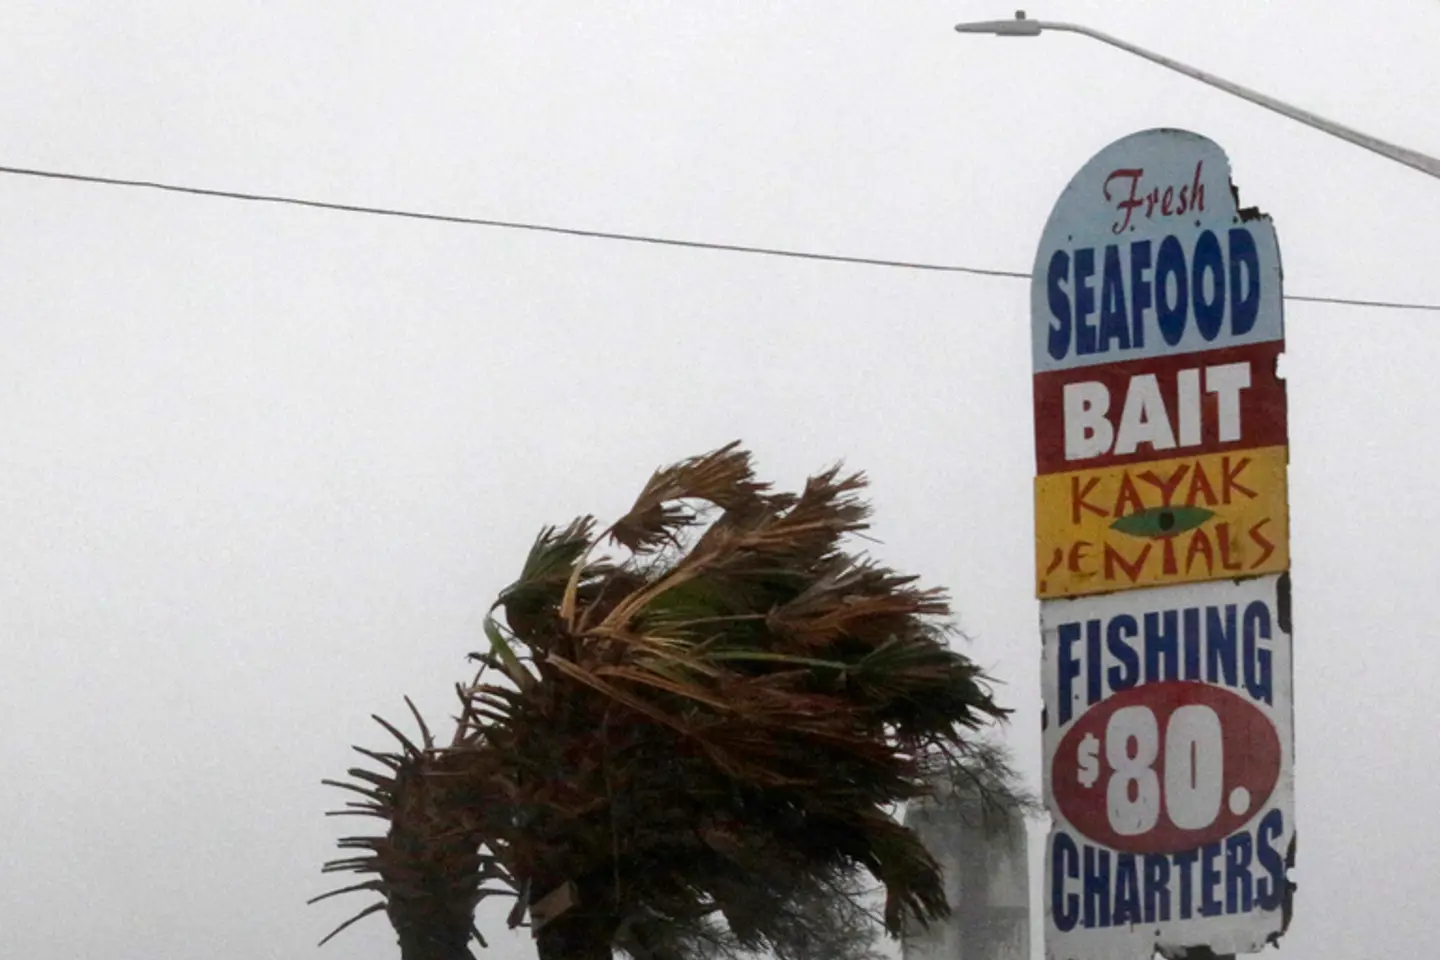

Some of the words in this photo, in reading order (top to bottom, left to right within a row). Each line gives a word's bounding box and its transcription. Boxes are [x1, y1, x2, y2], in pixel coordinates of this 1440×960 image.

[1103, 160, 1206, 235] Fresh
[1047, 228, 1260, 361] SEAFOOD
[1063, 361, 1252, 461] BAIT
[1071, 456, 1259, 524] KAYAK
[1057, 600, 1274, 728] FISHING
[1052, 808, 1285, 933] CHARTERS
